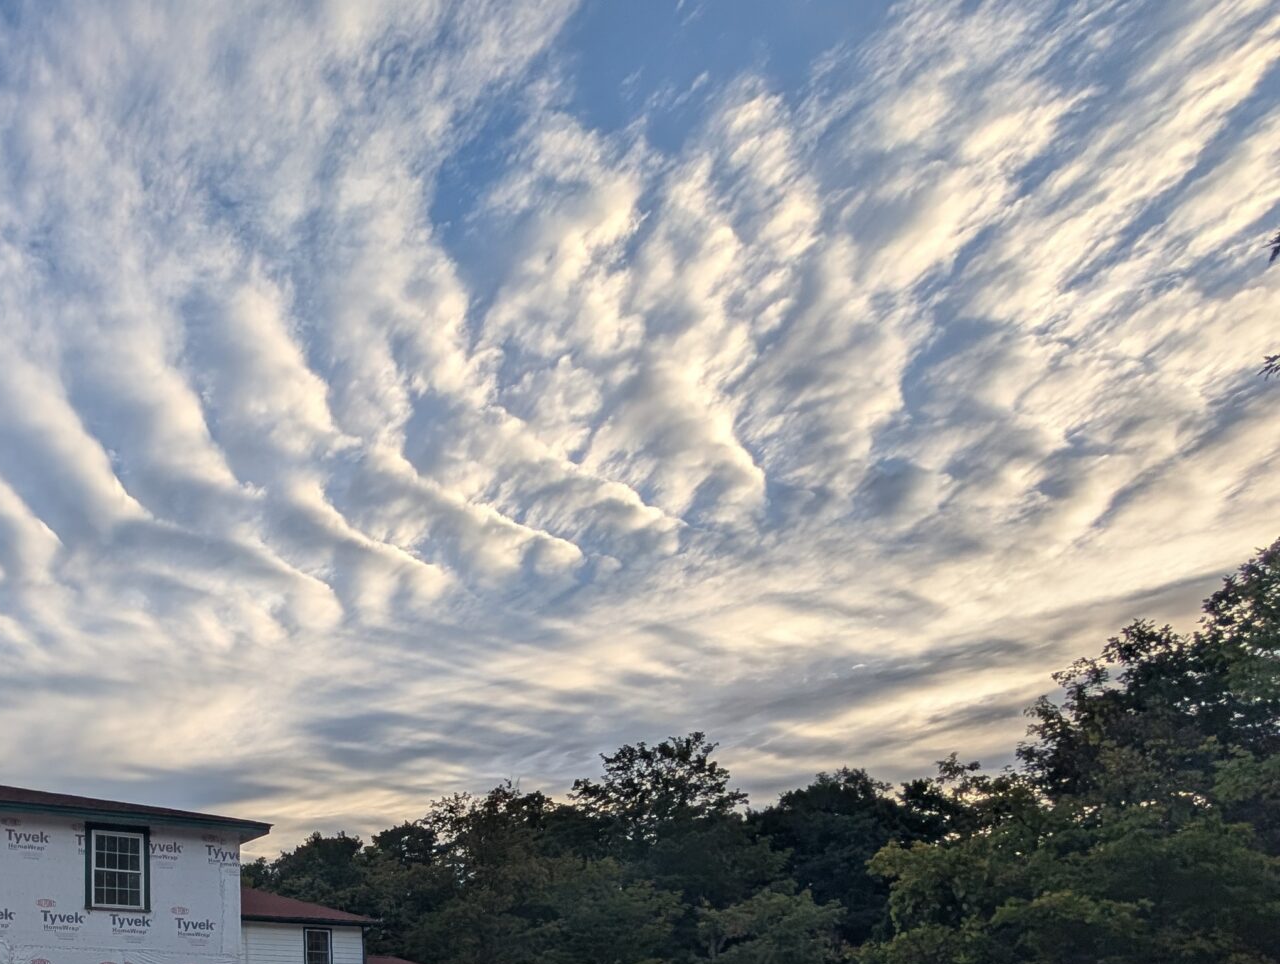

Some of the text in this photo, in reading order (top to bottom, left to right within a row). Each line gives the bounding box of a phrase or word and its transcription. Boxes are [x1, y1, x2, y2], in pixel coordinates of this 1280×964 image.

[5, 828, 49, 844] Tyvek
[149, 841, 182, 854] yvek
[40, 910, 83, 924] Tyvek
[109, 914, 151, 928] Tyvek
[175, 917, 215, 931] Tyvek
